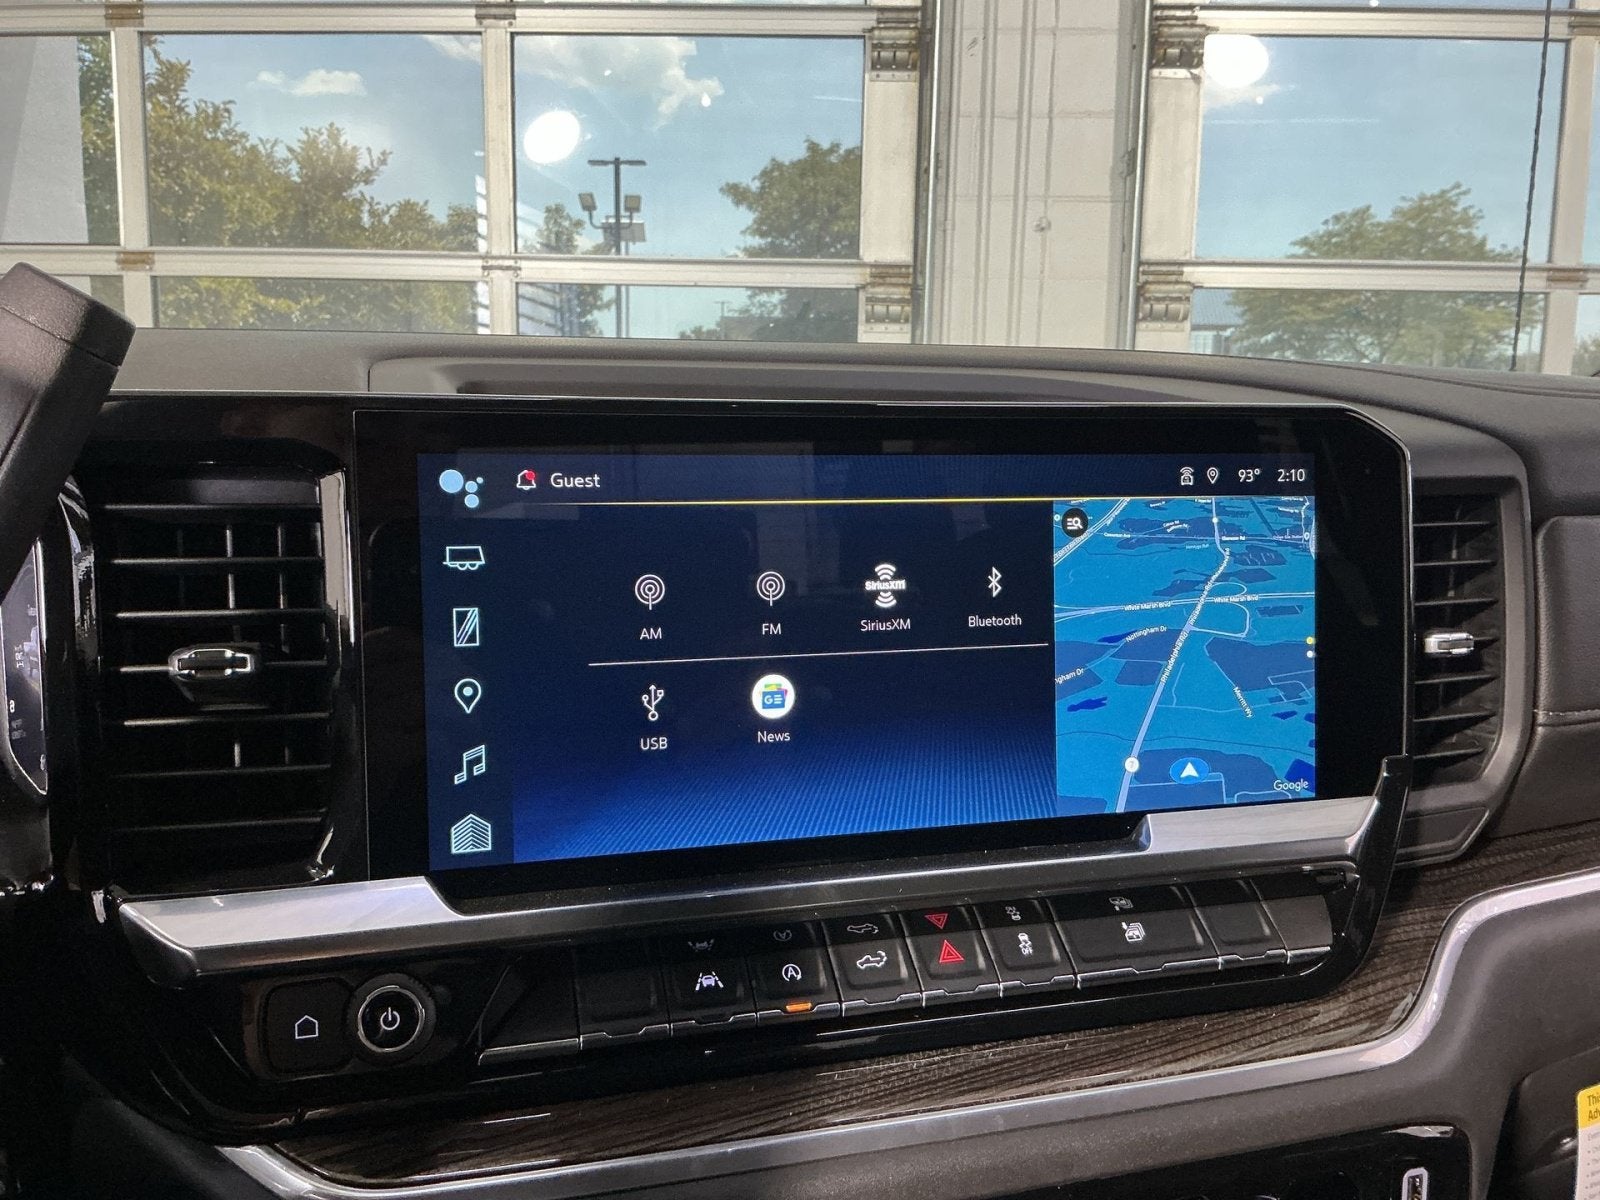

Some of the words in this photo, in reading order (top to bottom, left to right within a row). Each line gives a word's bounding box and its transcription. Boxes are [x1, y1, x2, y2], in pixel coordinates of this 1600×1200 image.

[550, 473, 601, 488] Guest
[1277, 468, 1306, 482] 2:10
[860, 618, 911, 632] SiriusXM
[968, 614, 1022, 627] Bluetooth
[639, 627, 662, 640] AM
[762, 623, 782, 635] FM
[1126, 627, 1159, 642] Nottingham
[1160, 640, 1183, 683] Philadelphia
[1076, 668, 1084, 676] Dr
[640, 737, 668, 750] USB
[757, 731, 791, 743] News
[1273, 779, 1309, 792] Google
[1587, 1092, 1600, 1107] Thi
